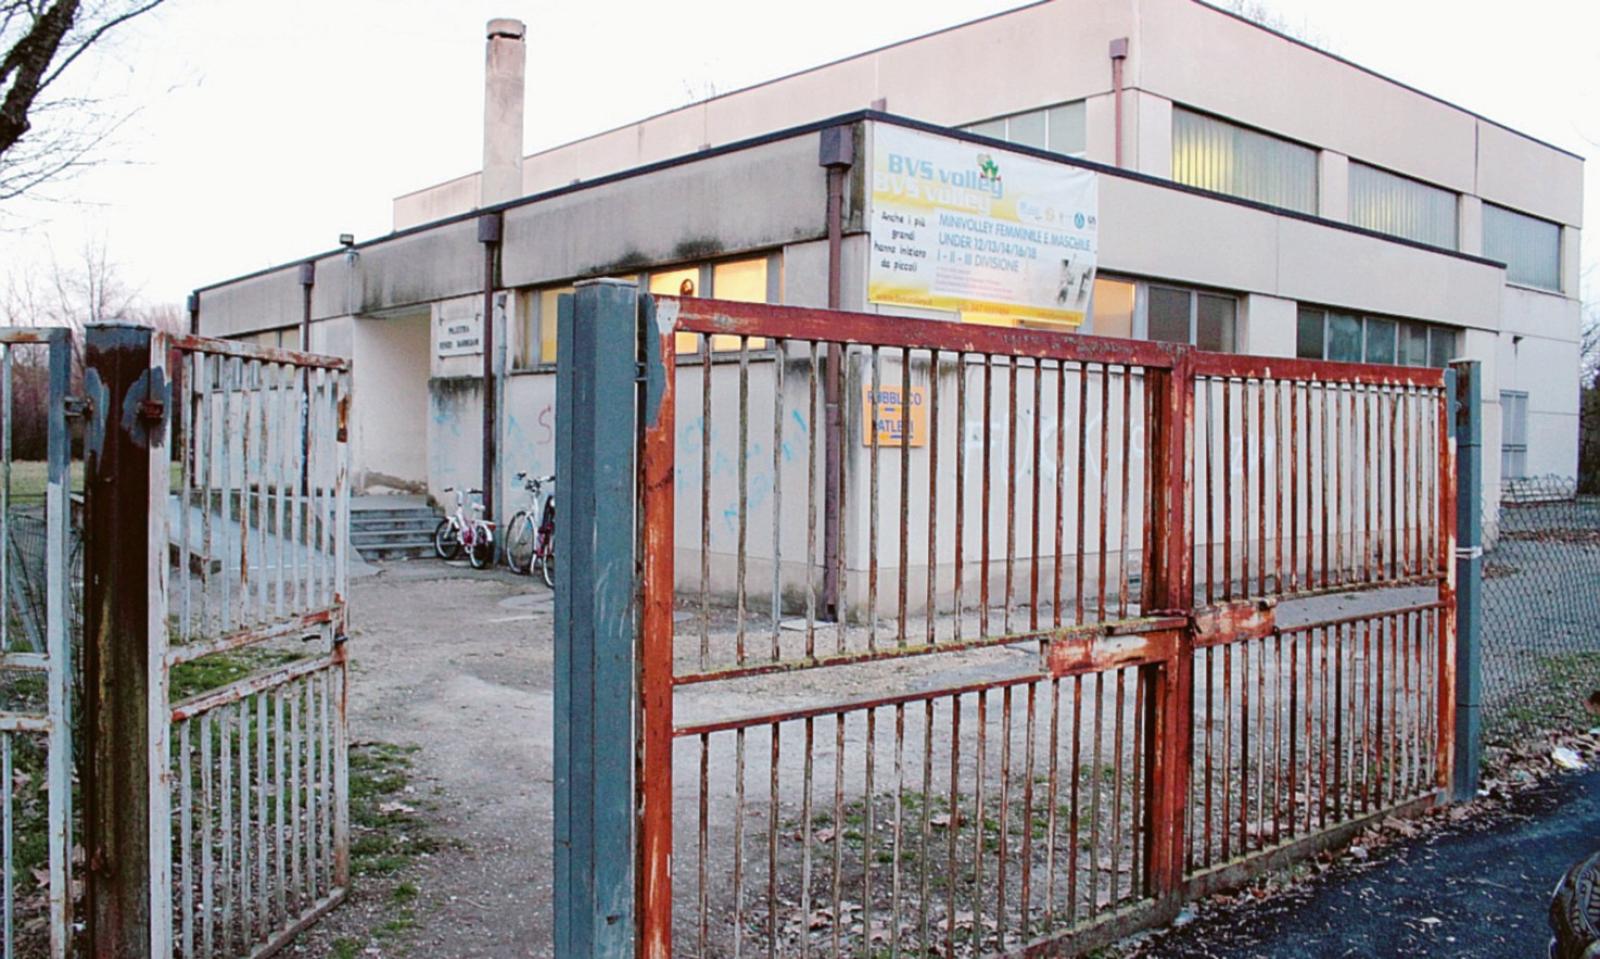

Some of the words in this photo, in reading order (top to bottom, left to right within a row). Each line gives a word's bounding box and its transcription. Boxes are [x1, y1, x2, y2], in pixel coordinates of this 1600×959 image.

[888, 153, 933, 181] BVS
[940, 168, 1004, 200] volley
[881, 211, 904, 224] Anche
[891, 229, 915, 241] grandi
[939, 212, 993, 234] MINIVOLLEY
[995, 222, 1042, 244] FEMMINILE
[1043, 231, 1050, 245] E
[938, 231, 972, 249] UNDER
[975, 254, 1019, 273] DIVISIONE
